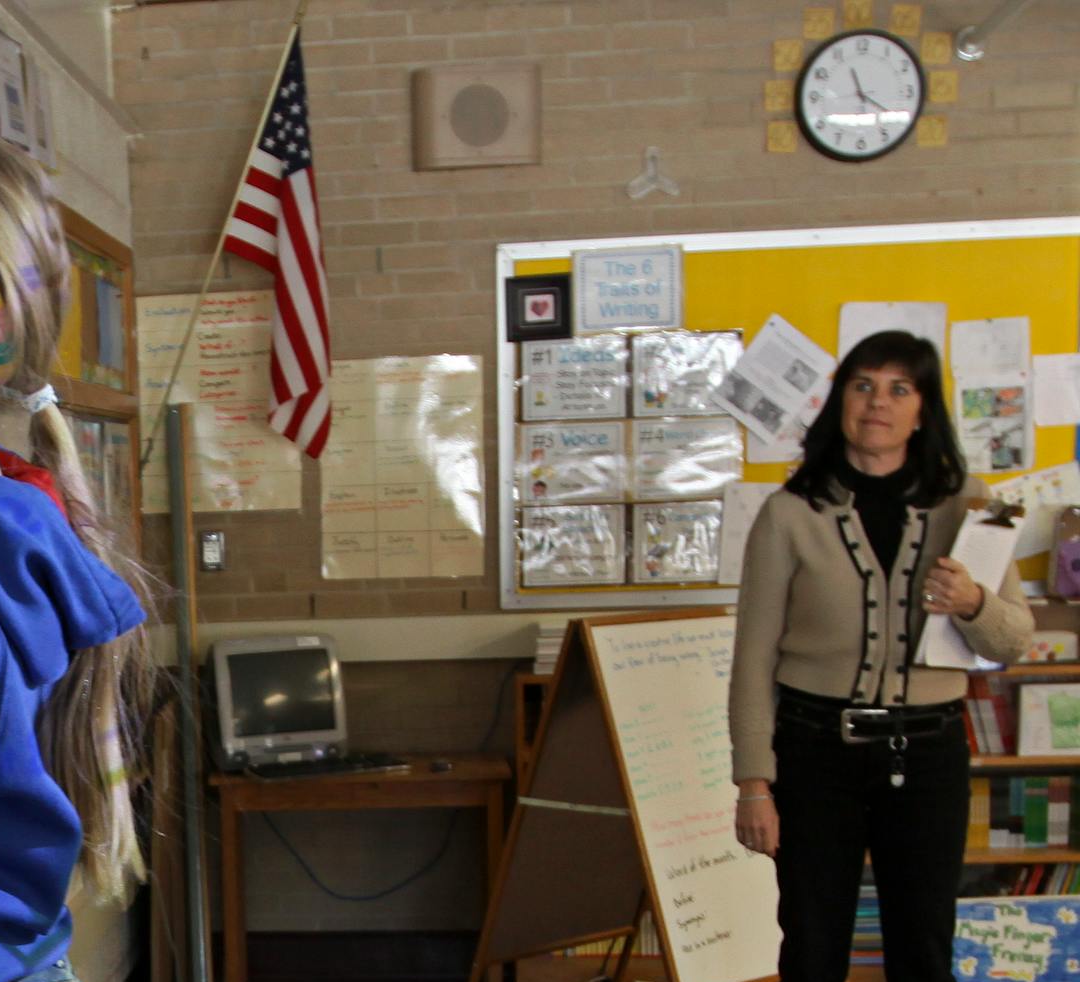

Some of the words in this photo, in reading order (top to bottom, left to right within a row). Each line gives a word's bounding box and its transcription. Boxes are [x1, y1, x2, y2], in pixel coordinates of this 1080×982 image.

[604, 260, 636, 277] The
[641, 258, 653, 275] 6
[645, 278, 663, 296] of
[598, 302, 660, 320] Writing
[560, 430, 609, 447] Voice
